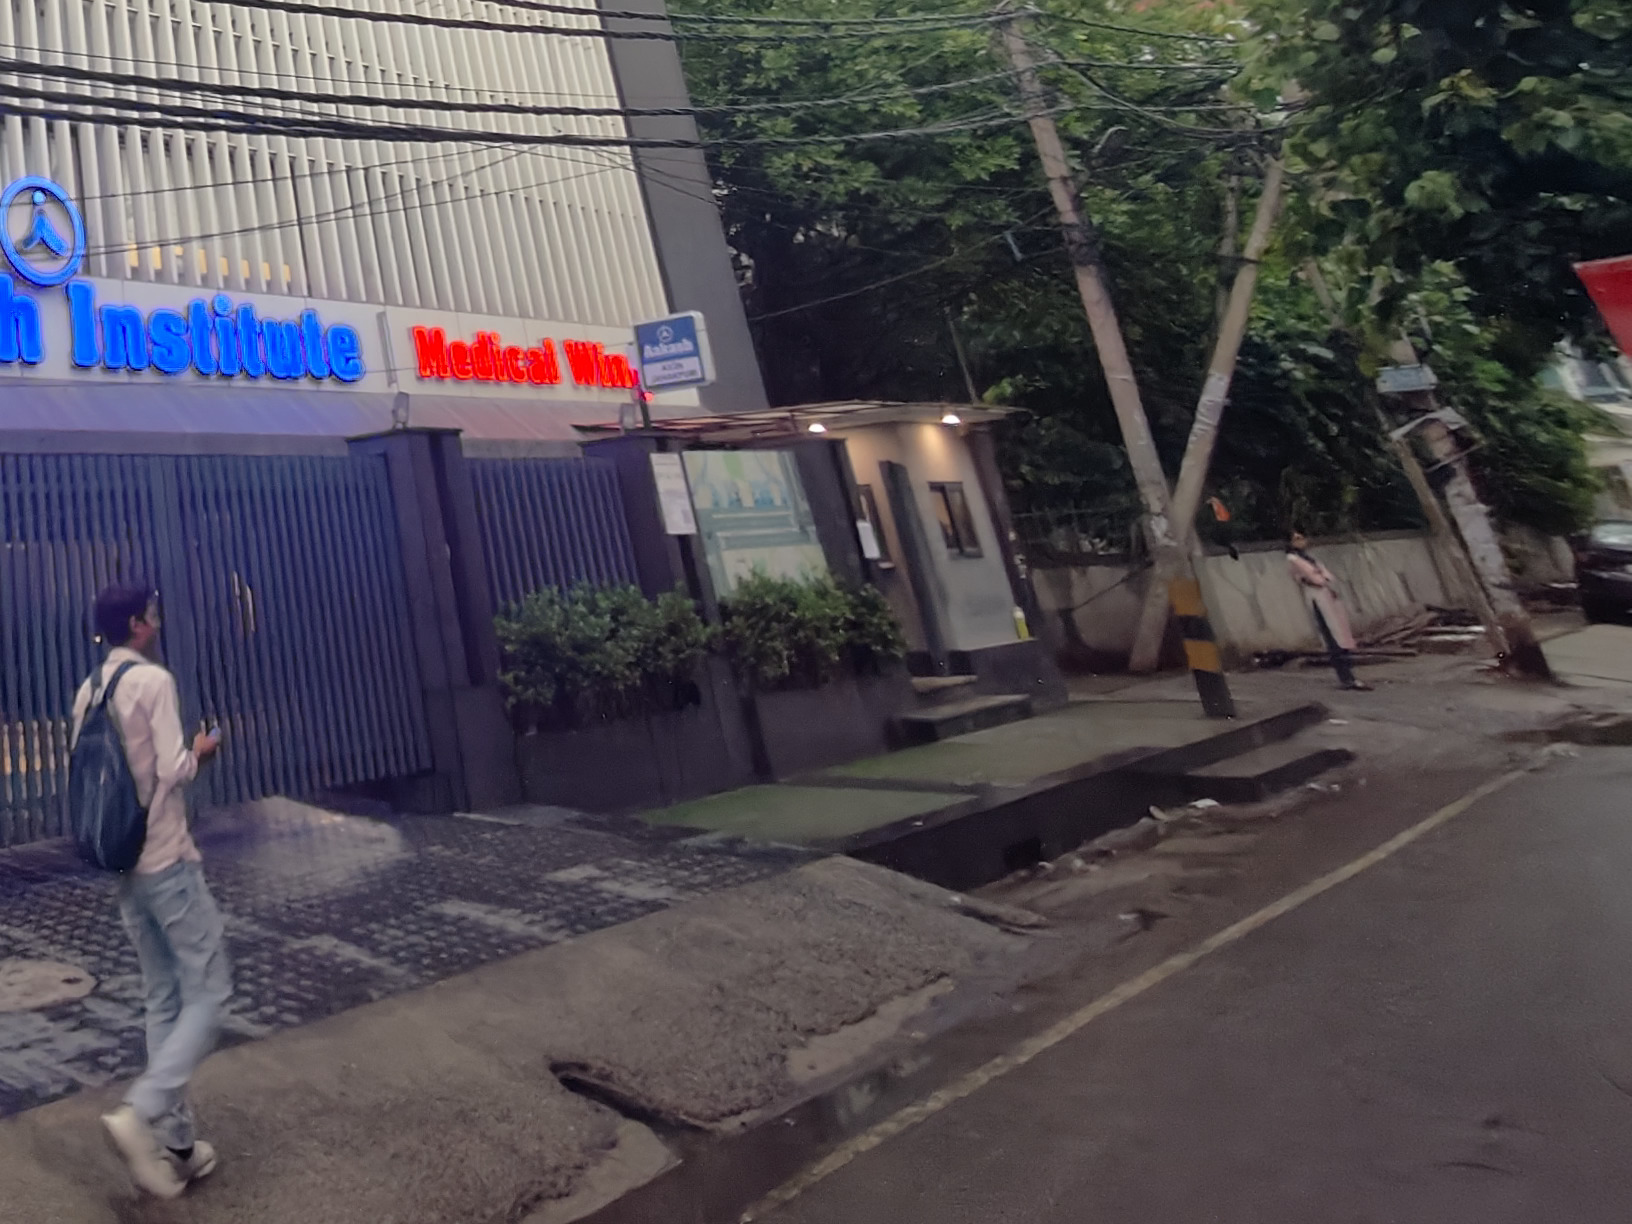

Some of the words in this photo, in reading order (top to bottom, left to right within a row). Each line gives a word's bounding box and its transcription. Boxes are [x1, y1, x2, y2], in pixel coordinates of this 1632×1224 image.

[66, 281, 366, 382] Institute
[413, 325, 562, 385] Medical
[563, 339, 639, 389] Win
